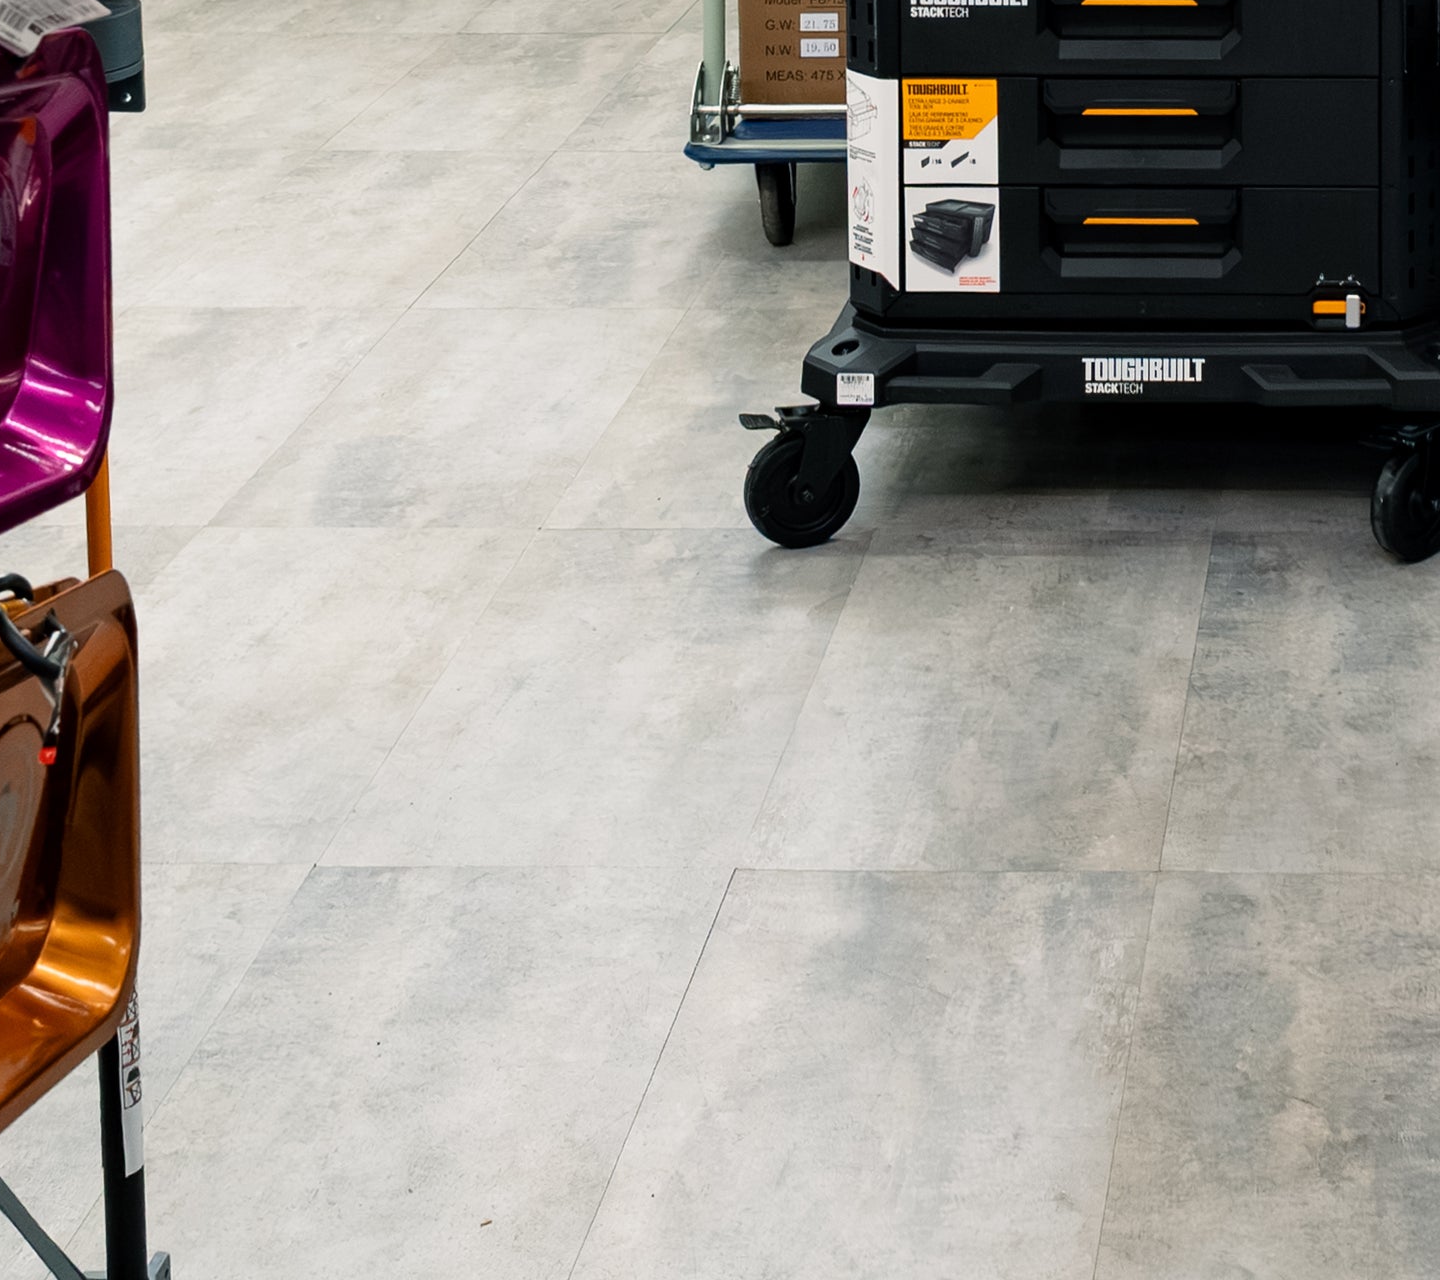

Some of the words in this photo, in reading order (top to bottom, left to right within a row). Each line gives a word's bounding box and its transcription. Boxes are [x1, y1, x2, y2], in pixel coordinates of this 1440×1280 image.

[910, 6, 970, 19] STACKTECH
[765, 69, 808, 82] MEAS:
[810, 70, 834, 81] 475
[1081, 357, 1206, 382] TOUGHBUILT
[1084, 381, 1144, 395] STACKTECH
